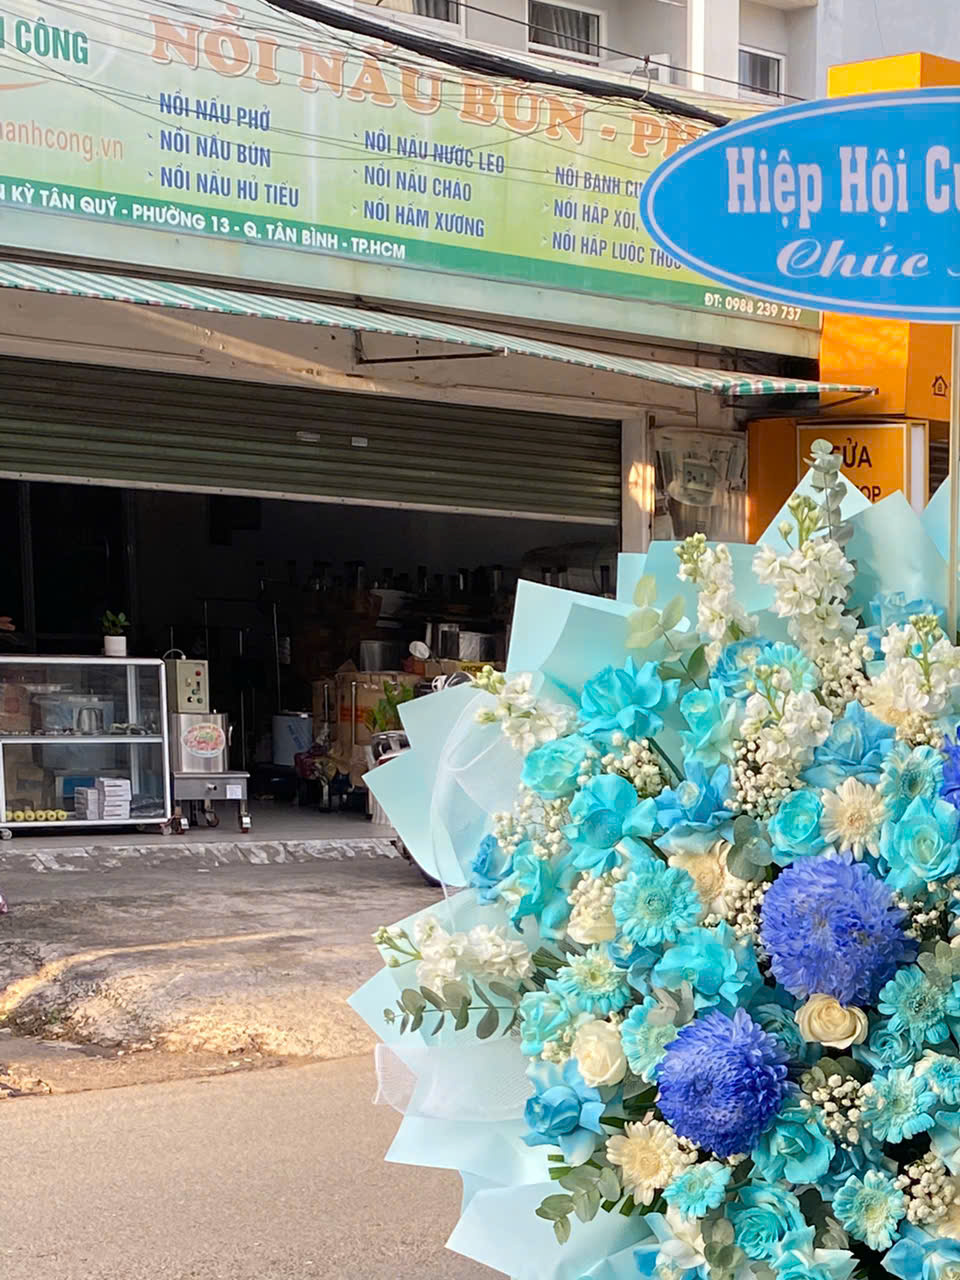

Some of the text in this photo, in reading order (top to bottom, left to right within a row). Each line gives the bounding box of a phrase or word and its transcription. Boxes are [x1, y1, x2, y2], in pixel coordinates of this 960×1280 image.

[15, 16, 88, 64] CÔNG
[237, 104, 271, 132] PHỞ
[196, 168, 231, 197] NẤU
[237, 174, 258, 201] HỦ
[265, 180, 299, 208] TIẾU
[396, 167, 427, 194] NẤU
[433, 177, 472, 202] CHÁO
[725, 147, 823, 229] Hiệp
[839, 146, 909, 228] Hội
[11, 183, 35, 205] KỲ
[39, 186, 75, 210] TÂN
[80, 196, 117, 217] QUÝ
[132, 204, 206, 230] PHƯỜNG
[211, 215, 230, 233] 13
[243, 221, 262, 239] Q.
[265, 221, 297, 243] TÂN
[301, 226, 338, 249] BÌNH
[350, 237, 406, 259] TP.HCM
[435, 211, 485, 238] XƯƠNG
[776, 238, 931, 279] Chúc
[704, 292, 801, 321] ĐT: 0988 239 737
[832, 437, 872, 468] ỬA
